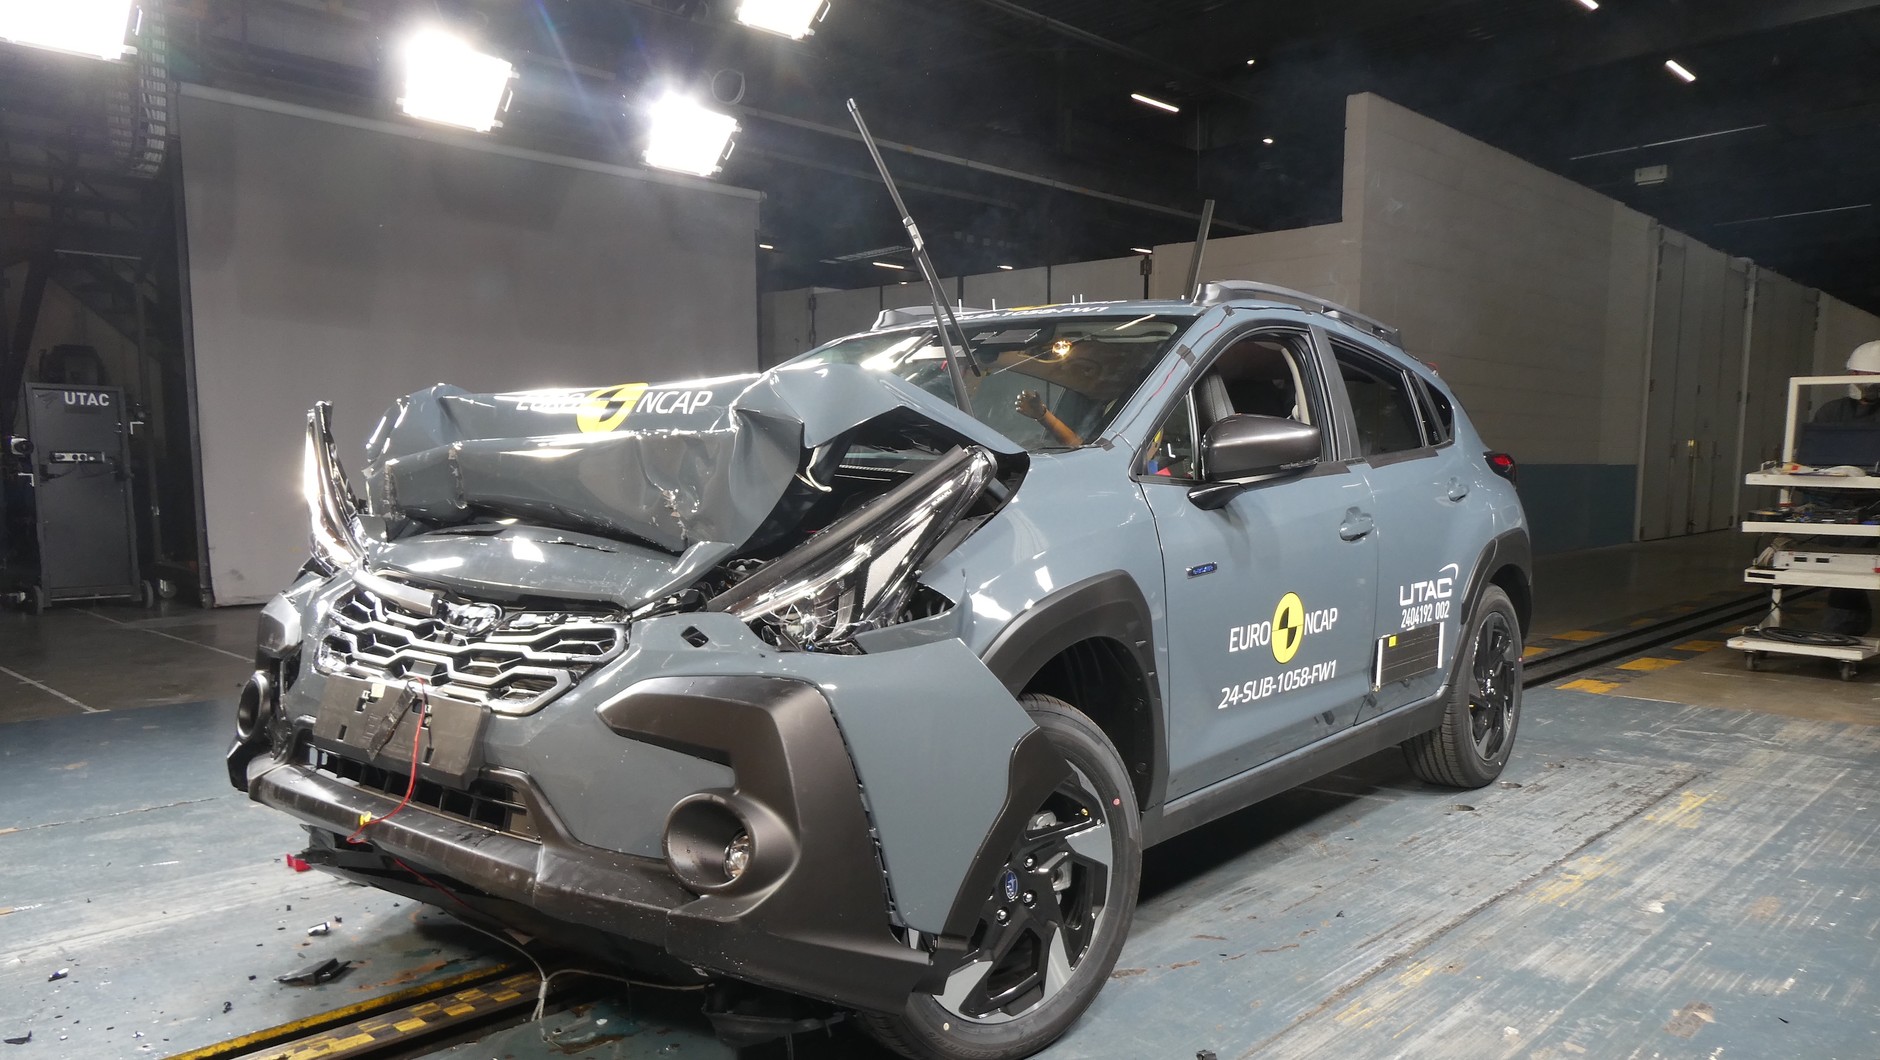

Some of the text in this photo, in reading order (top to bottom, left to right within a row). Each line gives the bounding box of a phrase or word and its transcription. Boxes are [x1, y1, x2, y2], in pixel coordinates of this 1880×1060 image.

[64, 391, 110, 407] UTAC
[635, 390, 713, 415] NCAP
[1399, 577, 1453, 606] UTAC
[1400, 600, 1451, 629] 2404192 002
[1228, 607, 1338, 653] EURO NCAP
[1217, 659, 1338, 710] 24-SUB-1058-FW1
